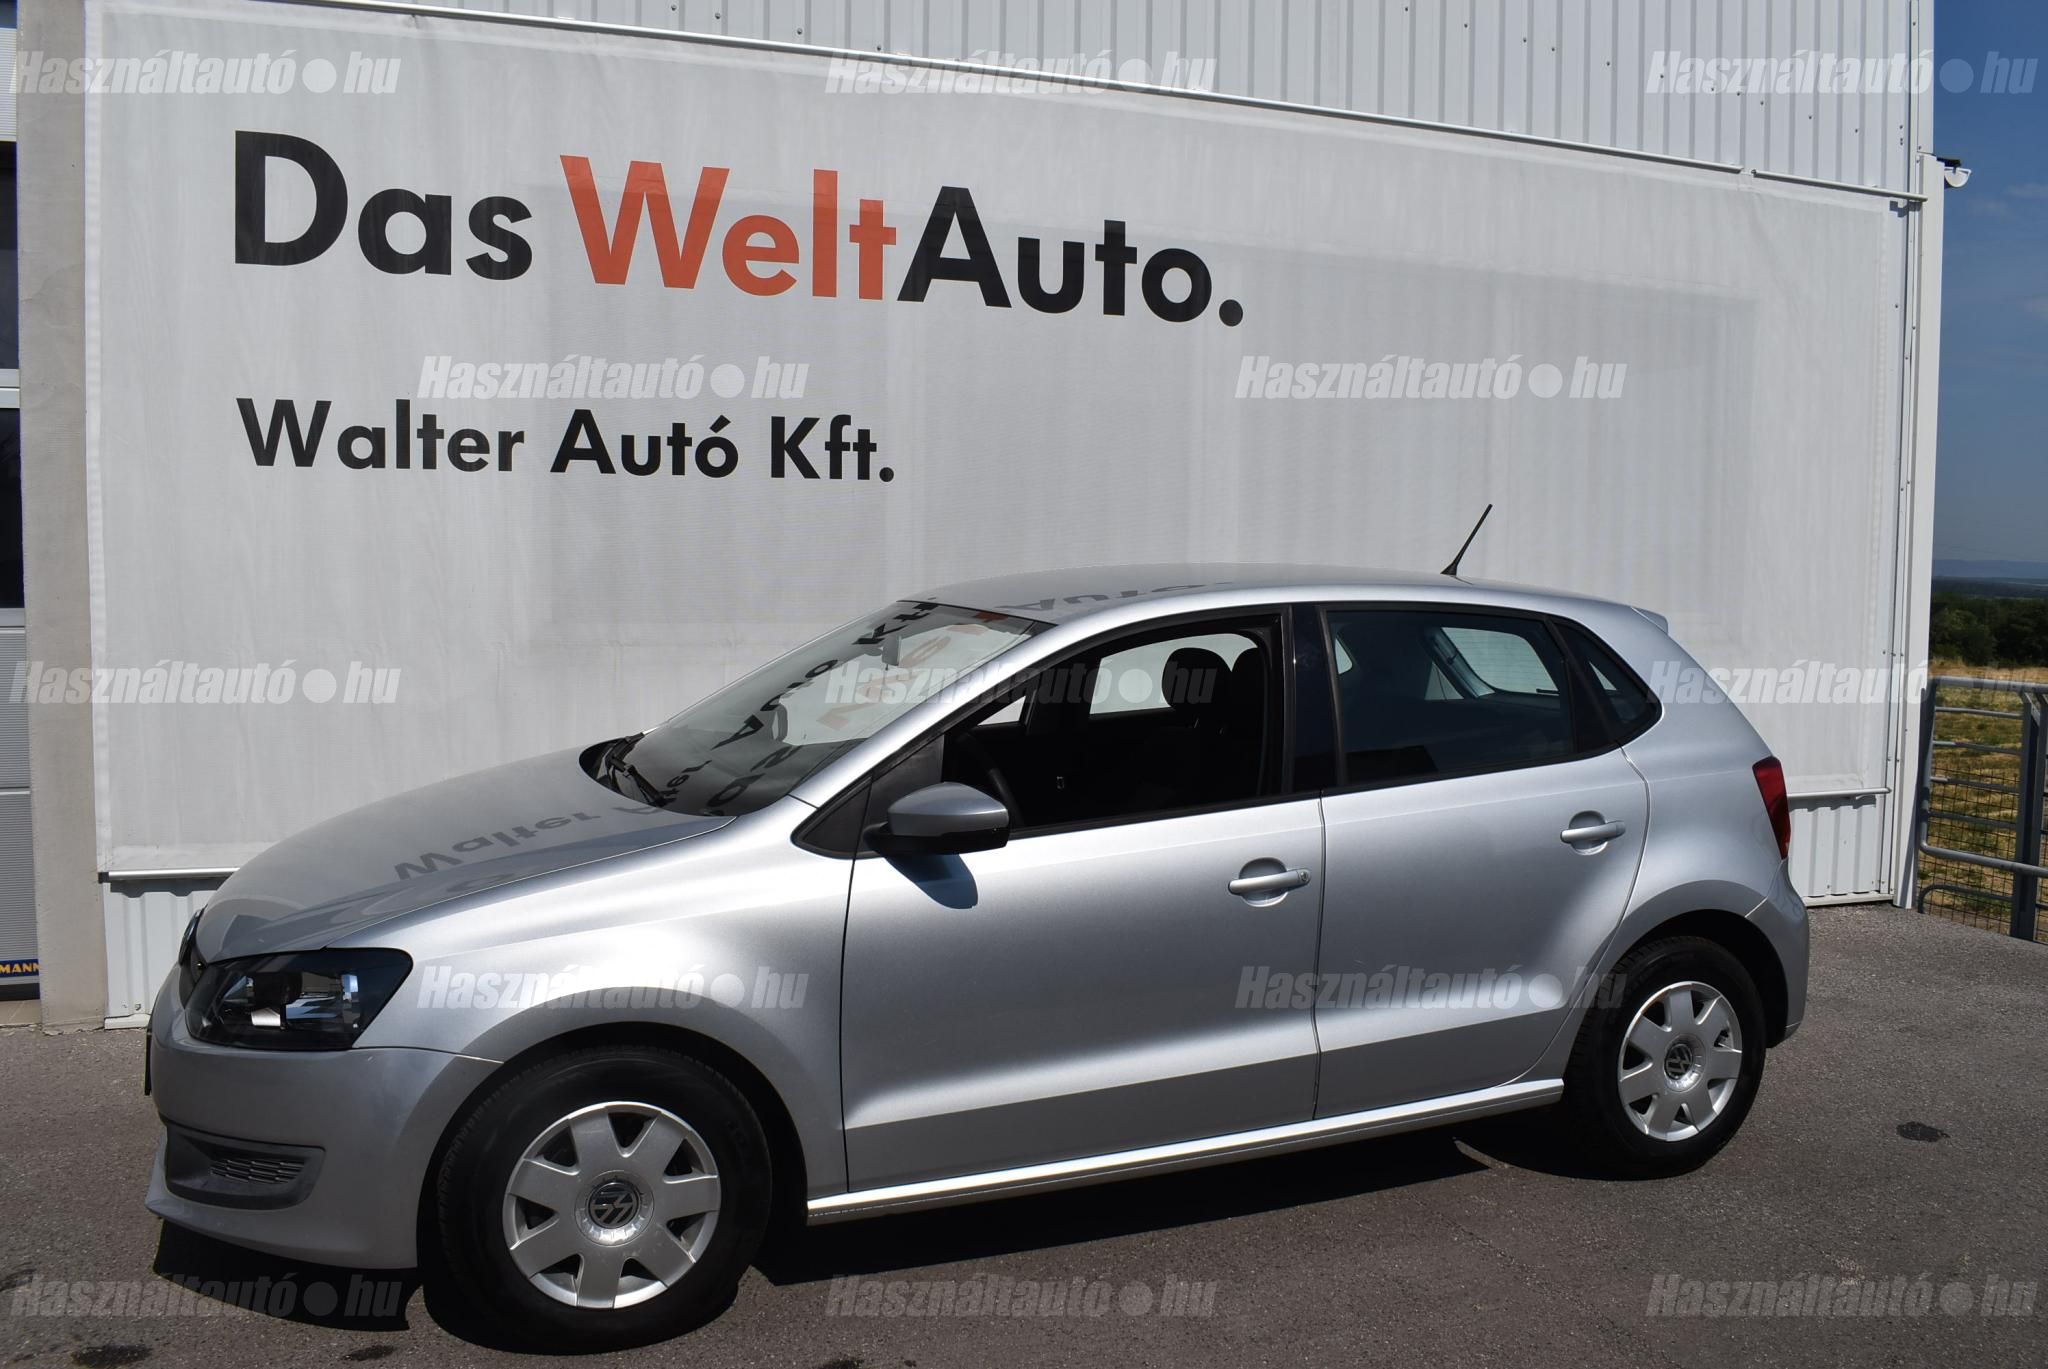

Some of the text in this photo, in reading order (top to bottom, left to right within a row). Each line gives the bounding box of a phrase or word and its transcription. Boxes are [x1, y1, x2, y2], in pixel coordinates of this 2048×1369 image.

[235, 130, 1244, 327] Das WeltAuto.
[236, 398, 895, 483] Walter Autó Kft.
